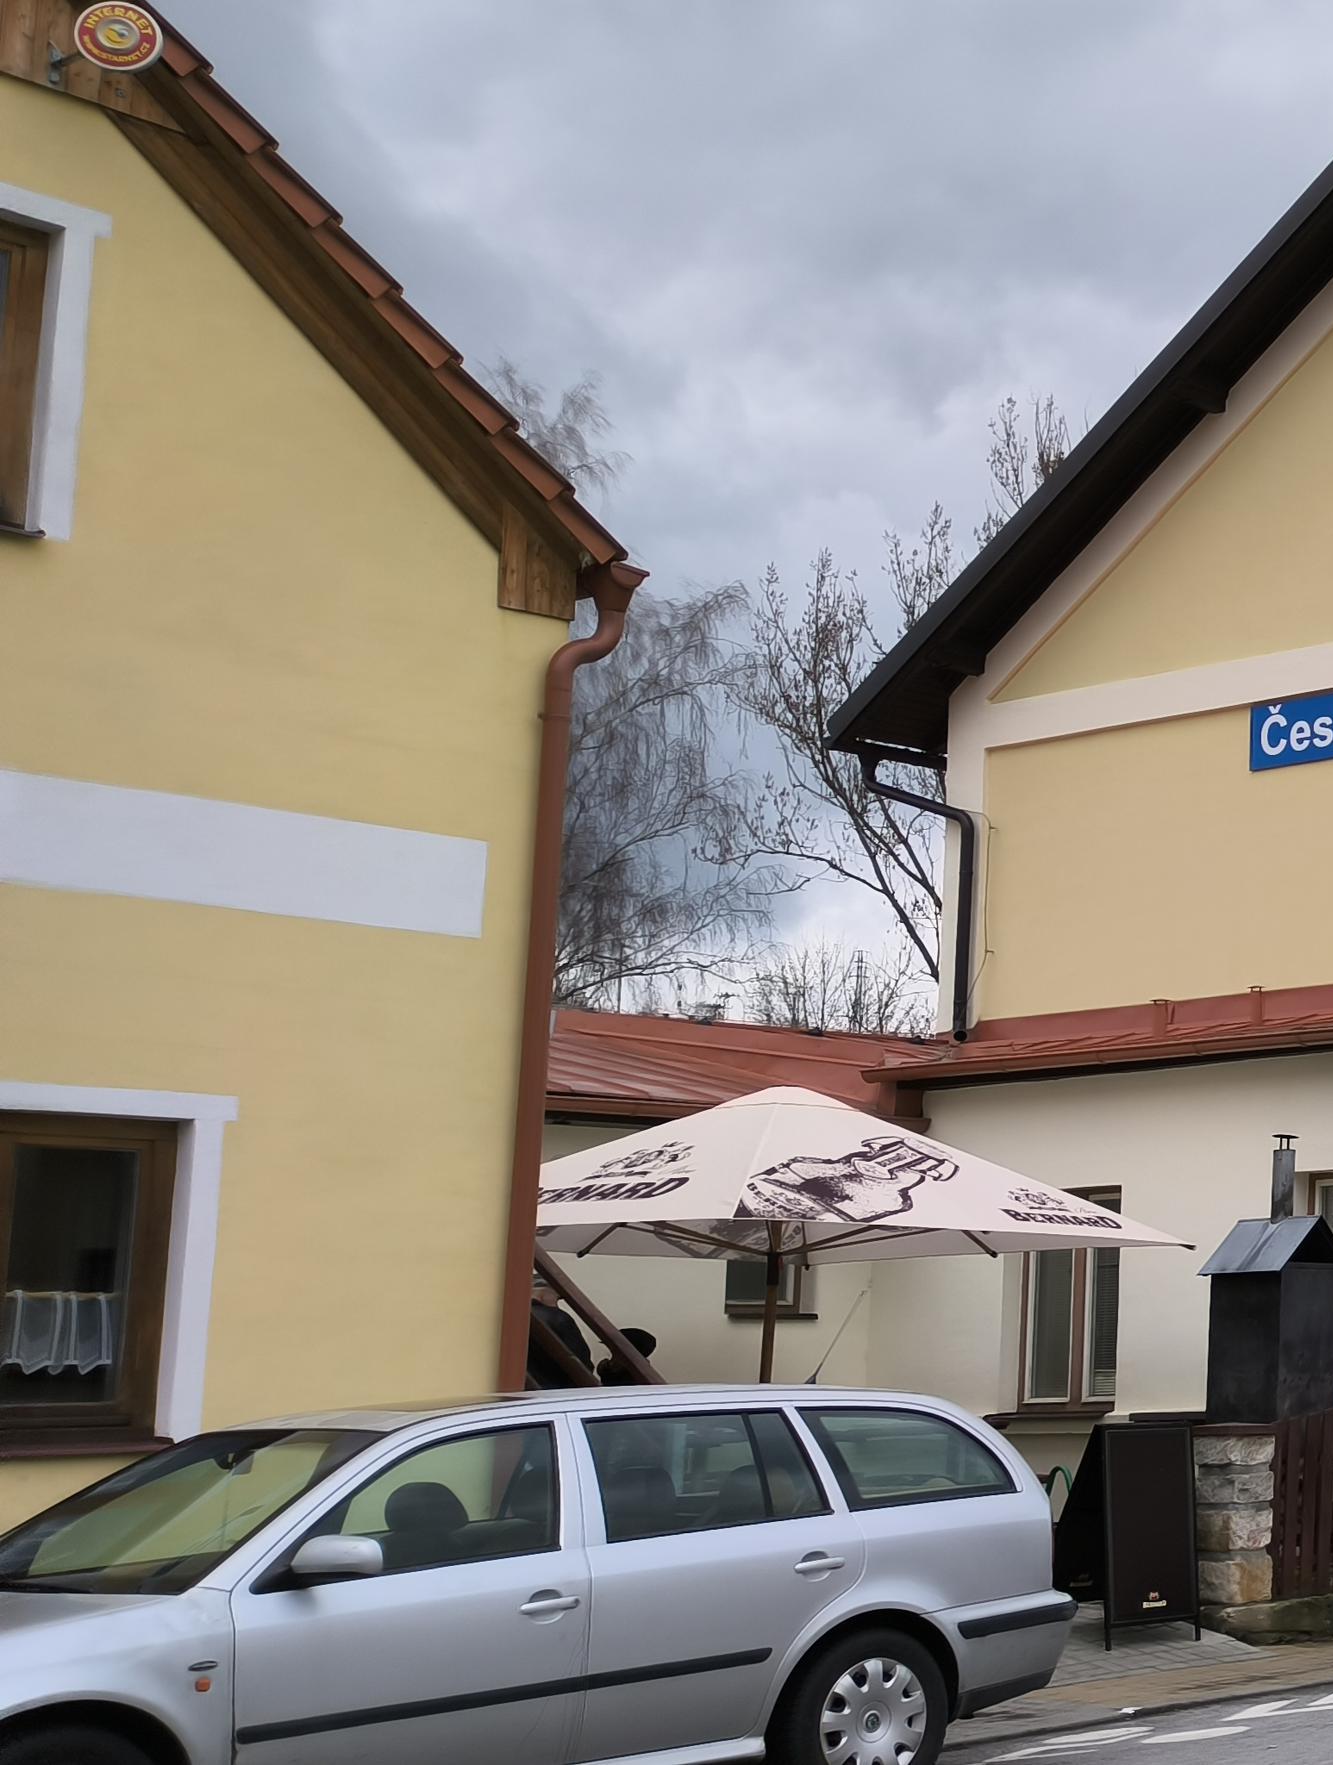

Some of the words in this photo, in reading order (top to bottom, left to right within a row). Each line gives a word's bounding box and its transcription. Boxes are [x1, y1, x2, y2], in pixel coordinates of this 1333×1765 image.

[83, 7, 153, 36] INTERNET
[537, 1177, 690, 1204] ERNARD
[999, 1208, 1122, 1229] BERNARD
